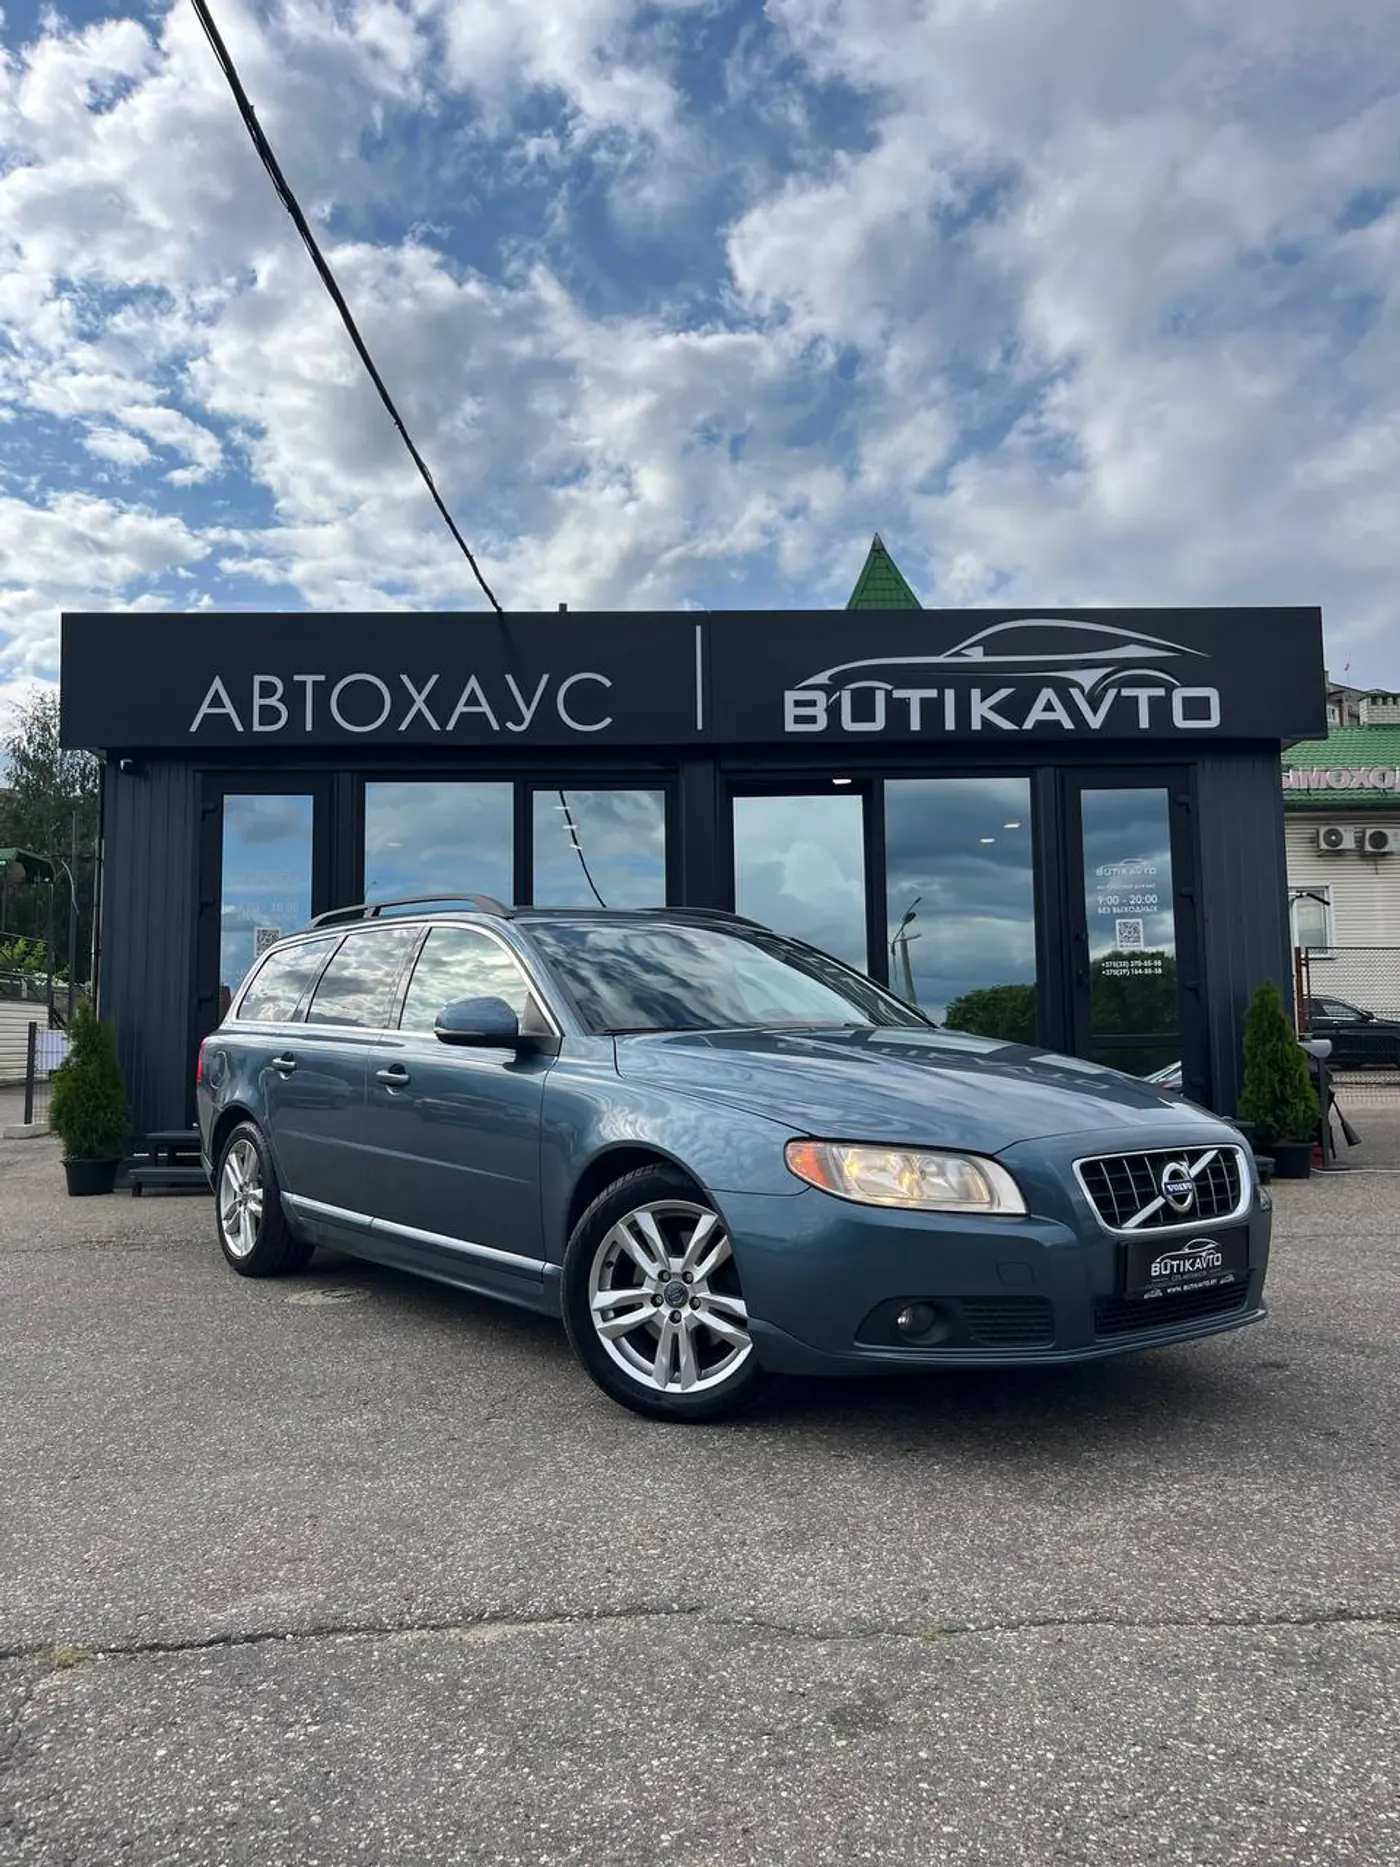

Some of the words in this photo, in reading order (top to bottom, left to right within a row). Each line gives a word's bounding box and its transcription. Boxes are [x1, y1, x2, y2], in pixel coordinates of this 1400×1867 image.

[189, 671, 614, 733] АВТОХАУС
[783, 686, 1221, 732] BUTIKAVTO
[1097, 895, 1120, 905] 9:00
[1129, 894, 1158, 904] 20:00
[1166, 1182, 1193, 1192] VOLVO
[1151, 1253, 1222, 1276] BUTIKAVTO
